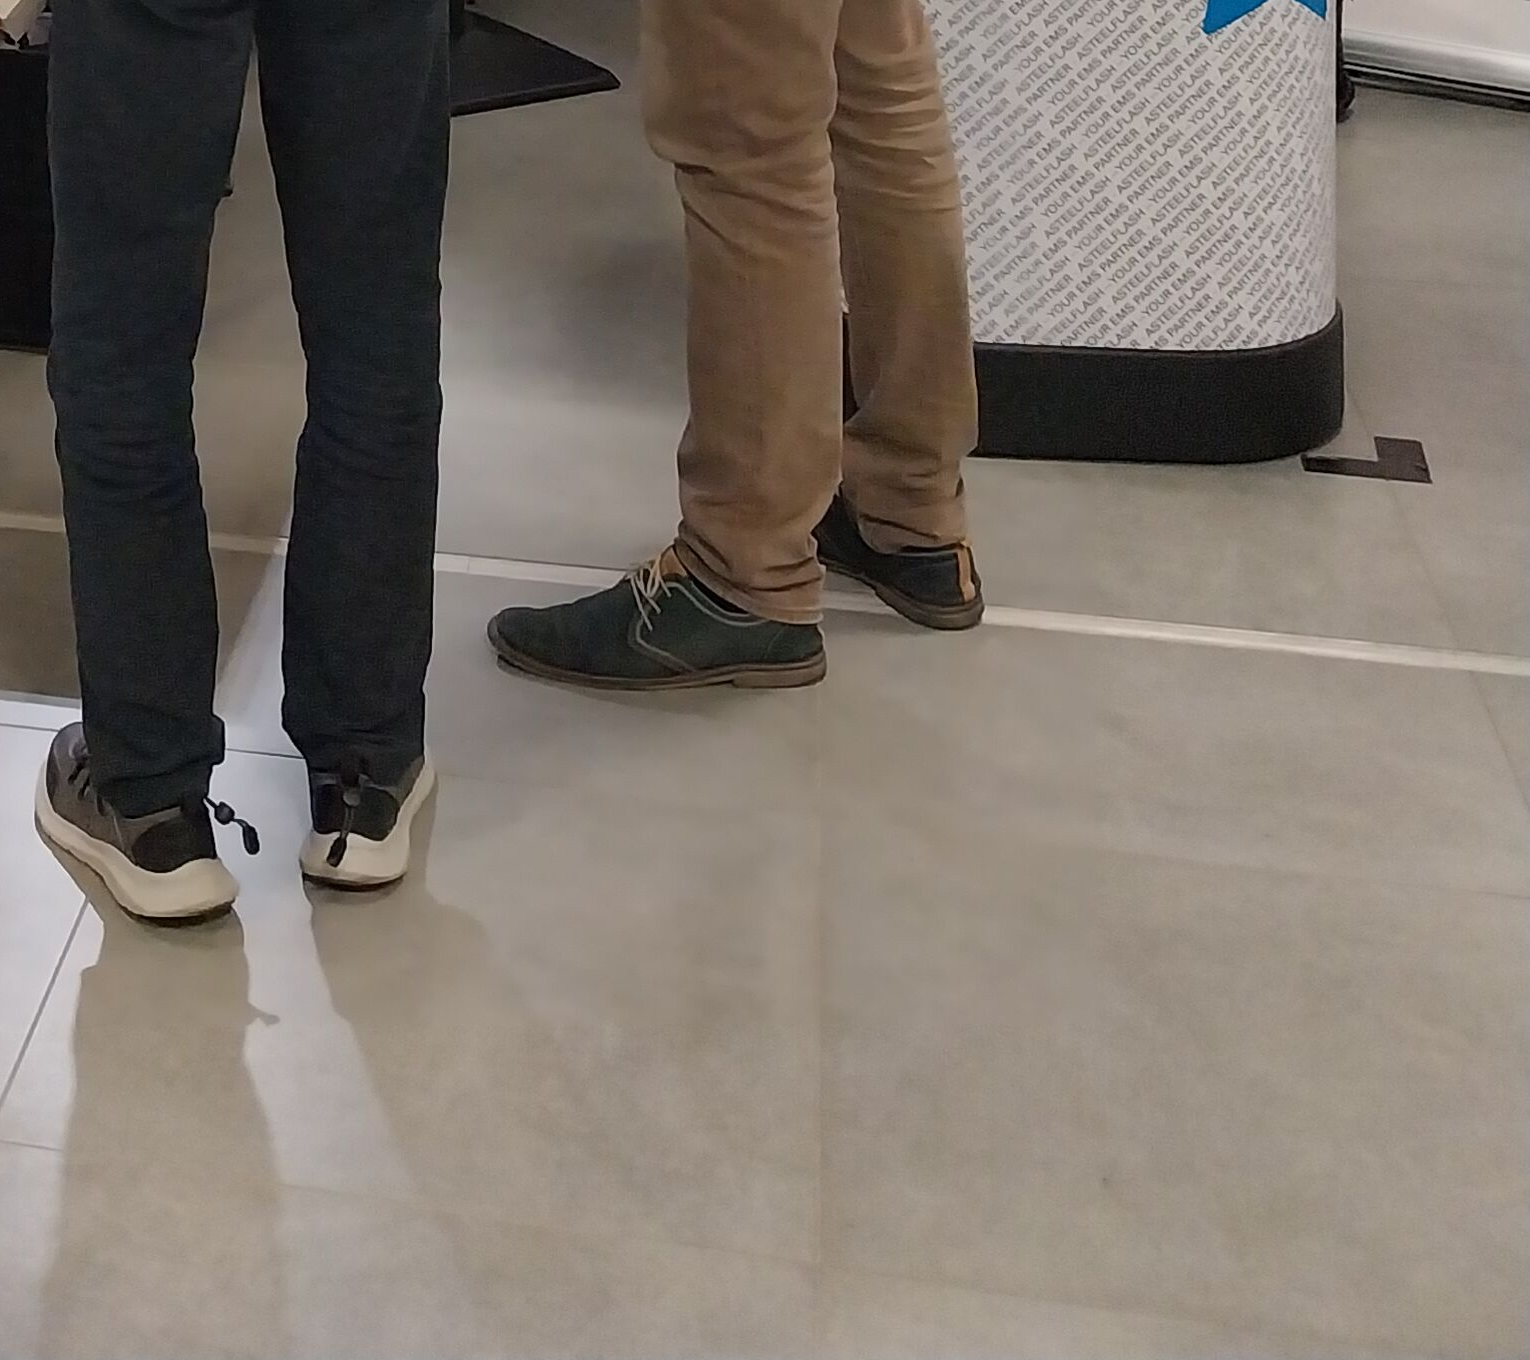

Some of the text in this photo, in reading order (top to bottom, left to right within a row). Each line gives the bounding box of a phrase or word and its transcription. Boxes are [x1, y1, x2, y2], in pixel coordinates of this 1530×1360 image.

[1015, 0, 1118, 96] ASTEELFLASH YOUR
[1043, 24, 1068, 48] EMS
[1047, 15, 1147, 106] YOUR EMS PARTNER
[1025, 63, 1073, 106] PARTNER
[1134, 47, 1182, 92] PARTNER
[1144, 60, 1212, 127] ASTEELFLASH
[1154, 42, 1208, 94] YOUR EMS
[1167, 79, 1215, 124] PARTNER
[1188, 73, 1241, 126] YOUR EMS
[1074, 202, 1129, 252] YOUR EMS
[1078, 207, 1146, 273] ASTEELFLASH
[1160, 192, 1207, 237] PARTNER
[1183, 191, 1249, 259] ASTEELFLASH
[1099, 228, 1147, 273] PARTNER
[1142, 266, 1196, 317] YOUR EMS
[1145, 272, 1213, 338] ASTEELFLASH
